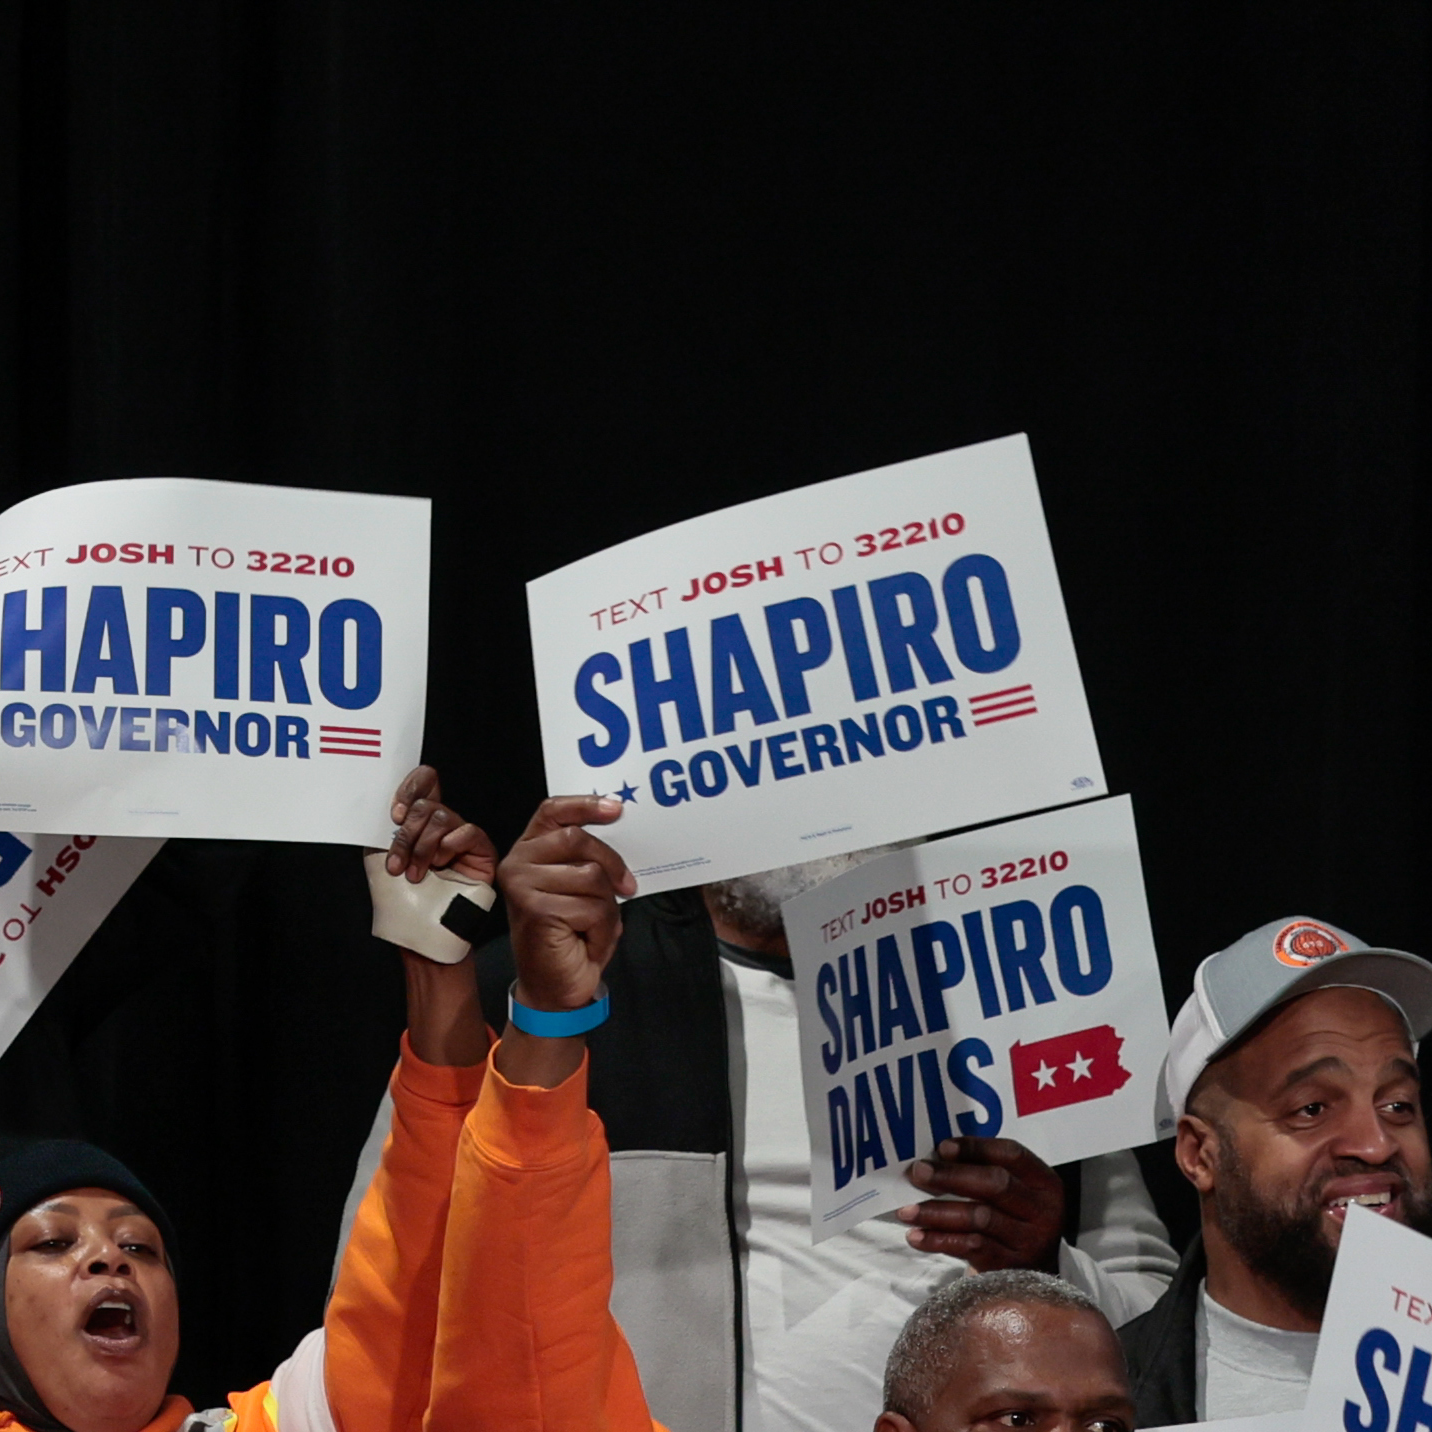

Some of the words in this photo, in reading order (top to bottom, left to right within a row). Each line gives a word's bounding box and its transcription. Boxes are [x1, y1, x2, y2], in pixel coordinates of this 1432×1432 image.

[66, 543, 175, 565] JOSH
[187, 547, 235, 570] TO
[246, 550, 356, 578] 32210
[589, 586, 669, 632] TEXT
[680, 556, 785, 602] JOSH
[794, 541, 844, 570] TO
[855, 512, 966, 557] 32210
[573, 553, 1022, 769] SHAPIRO
[0, 702, 310, 759] GOVERNOR
[648, 695, 966, 807] GOVERNOR
[3, 903, 42, 941] TO
[821, 908, 855, 944] TEXT
[860, 885, 926, 925] JOSH
[934, 872, 972, 899] TO
[979, 851, 1069, 890] 32210
[815, 884, 1114, 1075] SHAPIRO
[827, 1036, 1004, 1192] DAVIS
